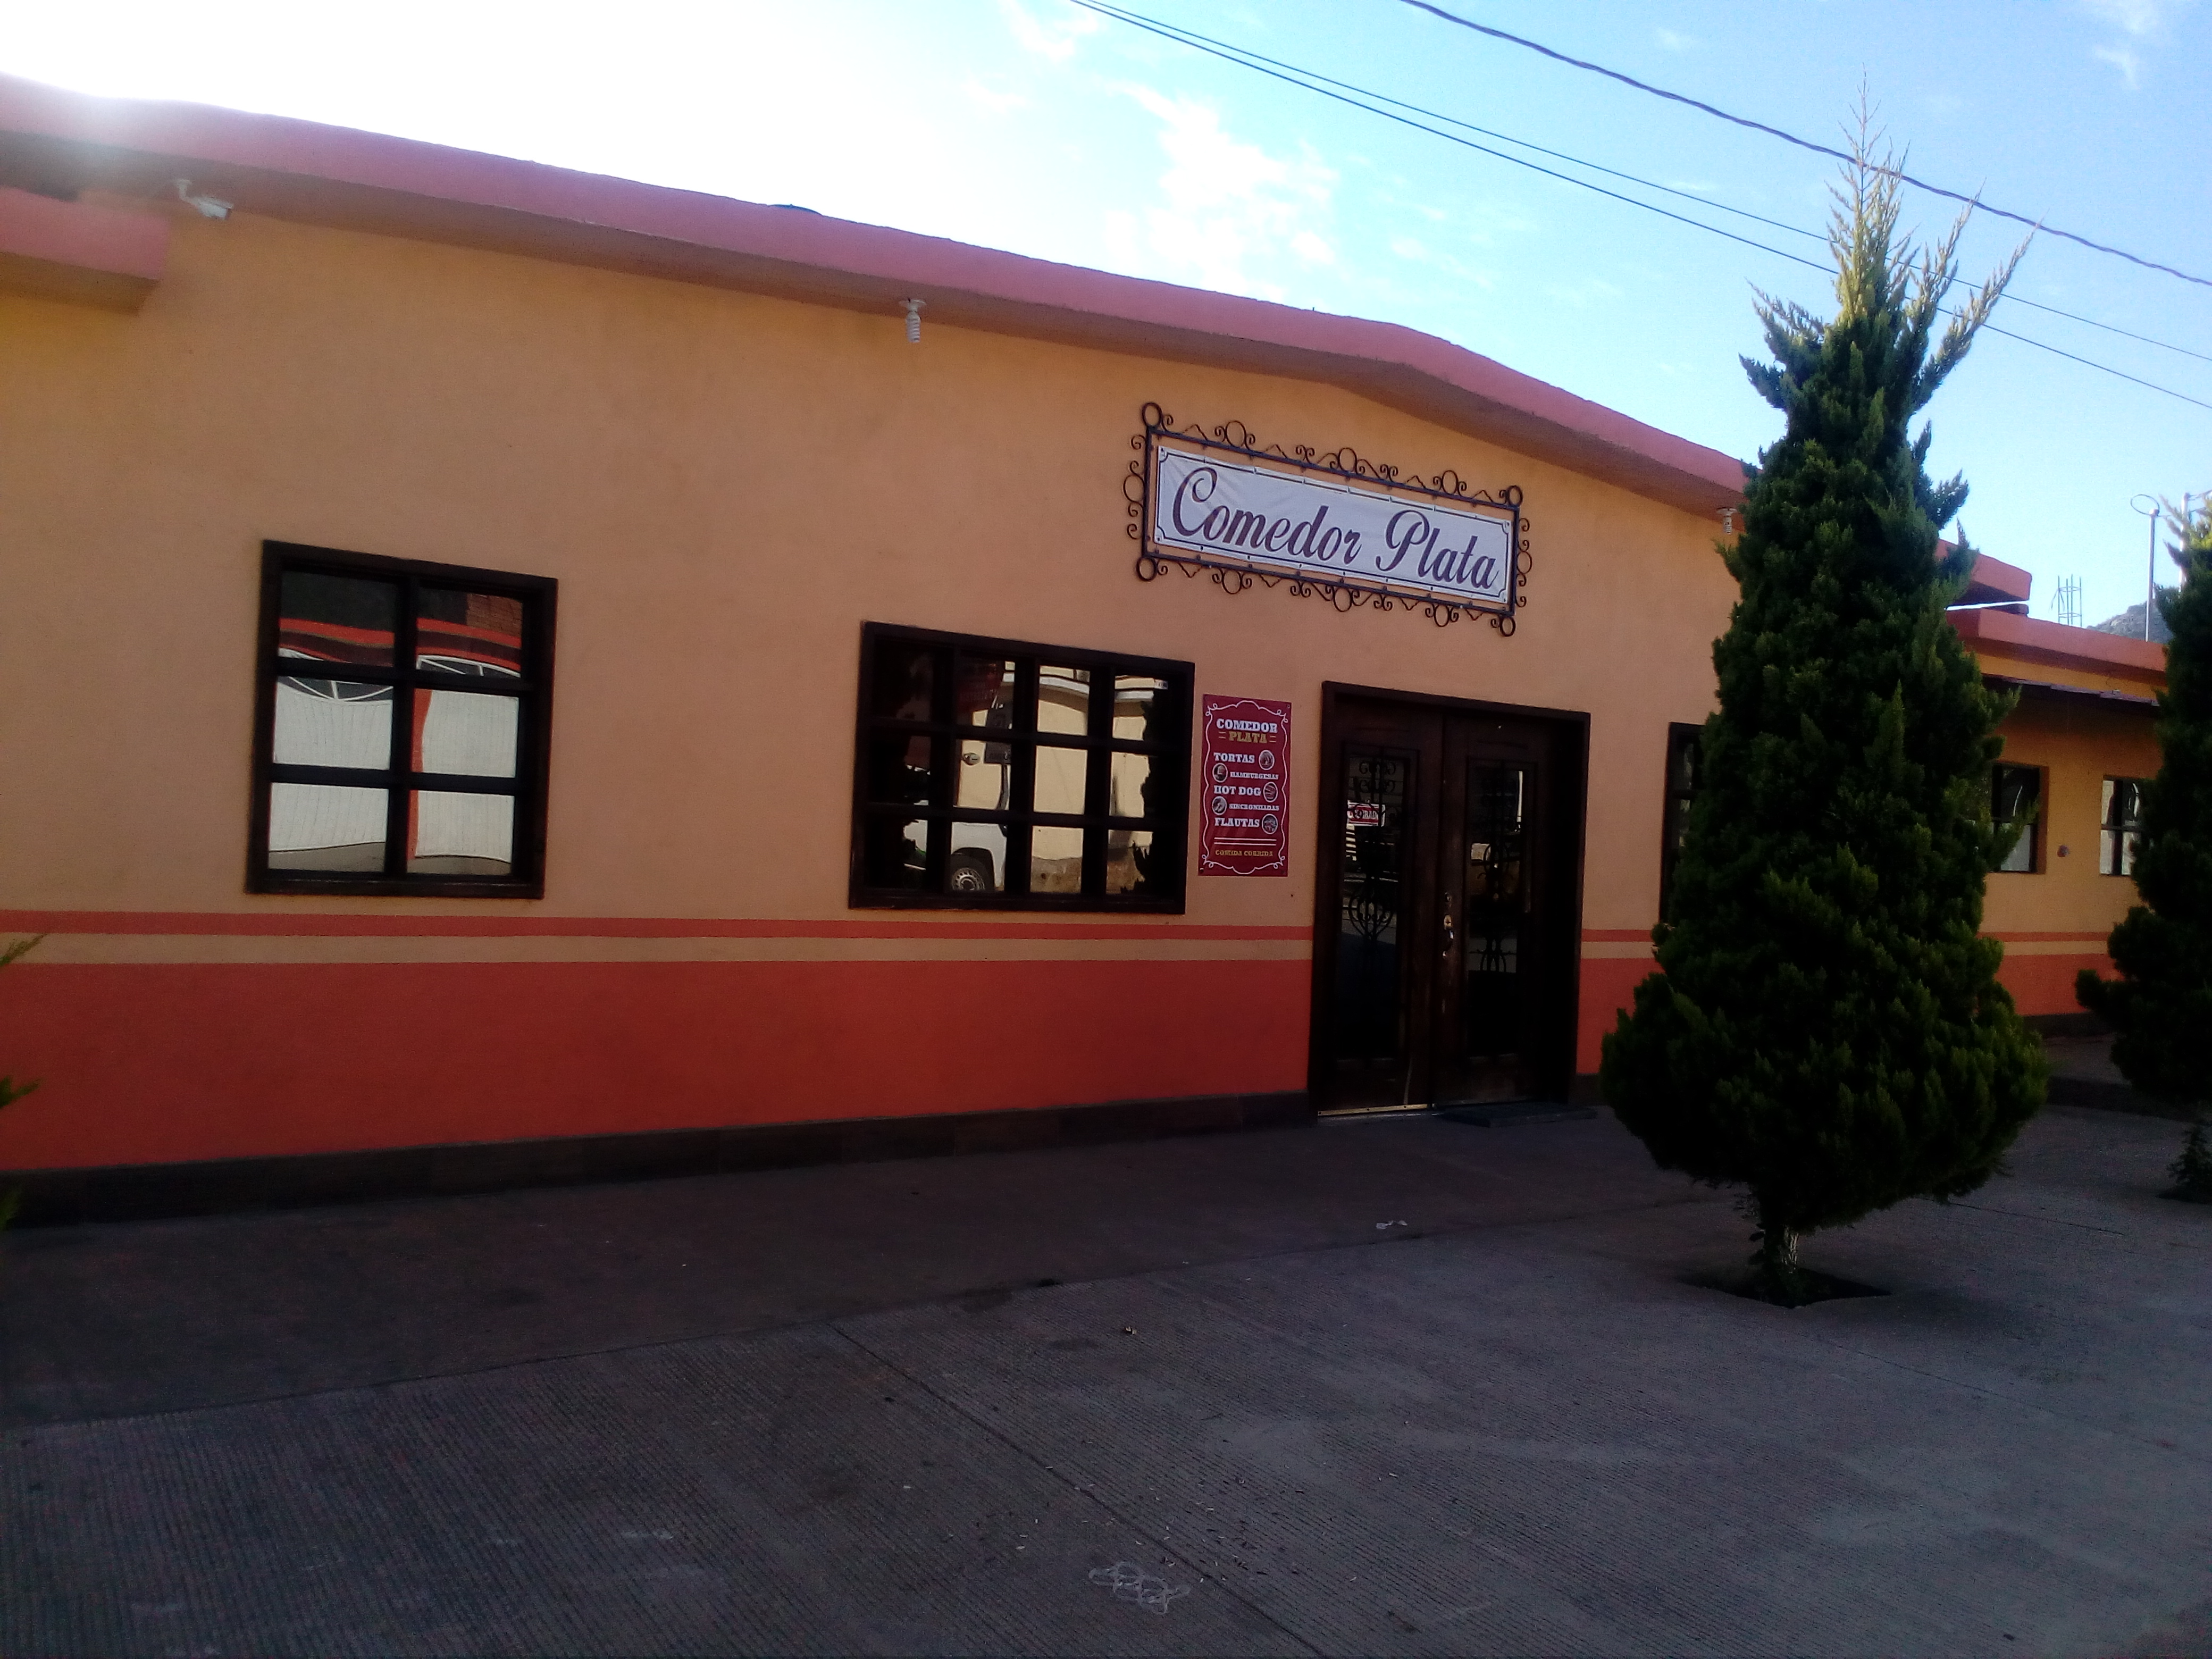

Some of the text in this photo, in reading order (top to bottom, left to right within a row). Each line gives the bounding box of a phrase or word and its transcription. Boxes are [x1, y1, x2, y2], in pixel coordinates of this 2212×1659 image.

[1171, 466, 1498, 590] Comedor Plata
[1216, 718, 1278, 733] COMEDOR
[1229, 731, 1268, 743] PLATA
[1213, 752, 1255, 763] TORTAS
[1214, 785, 1262, 797] HOT DOG
[1214, 817, 1260, 827] FLAUTAS
